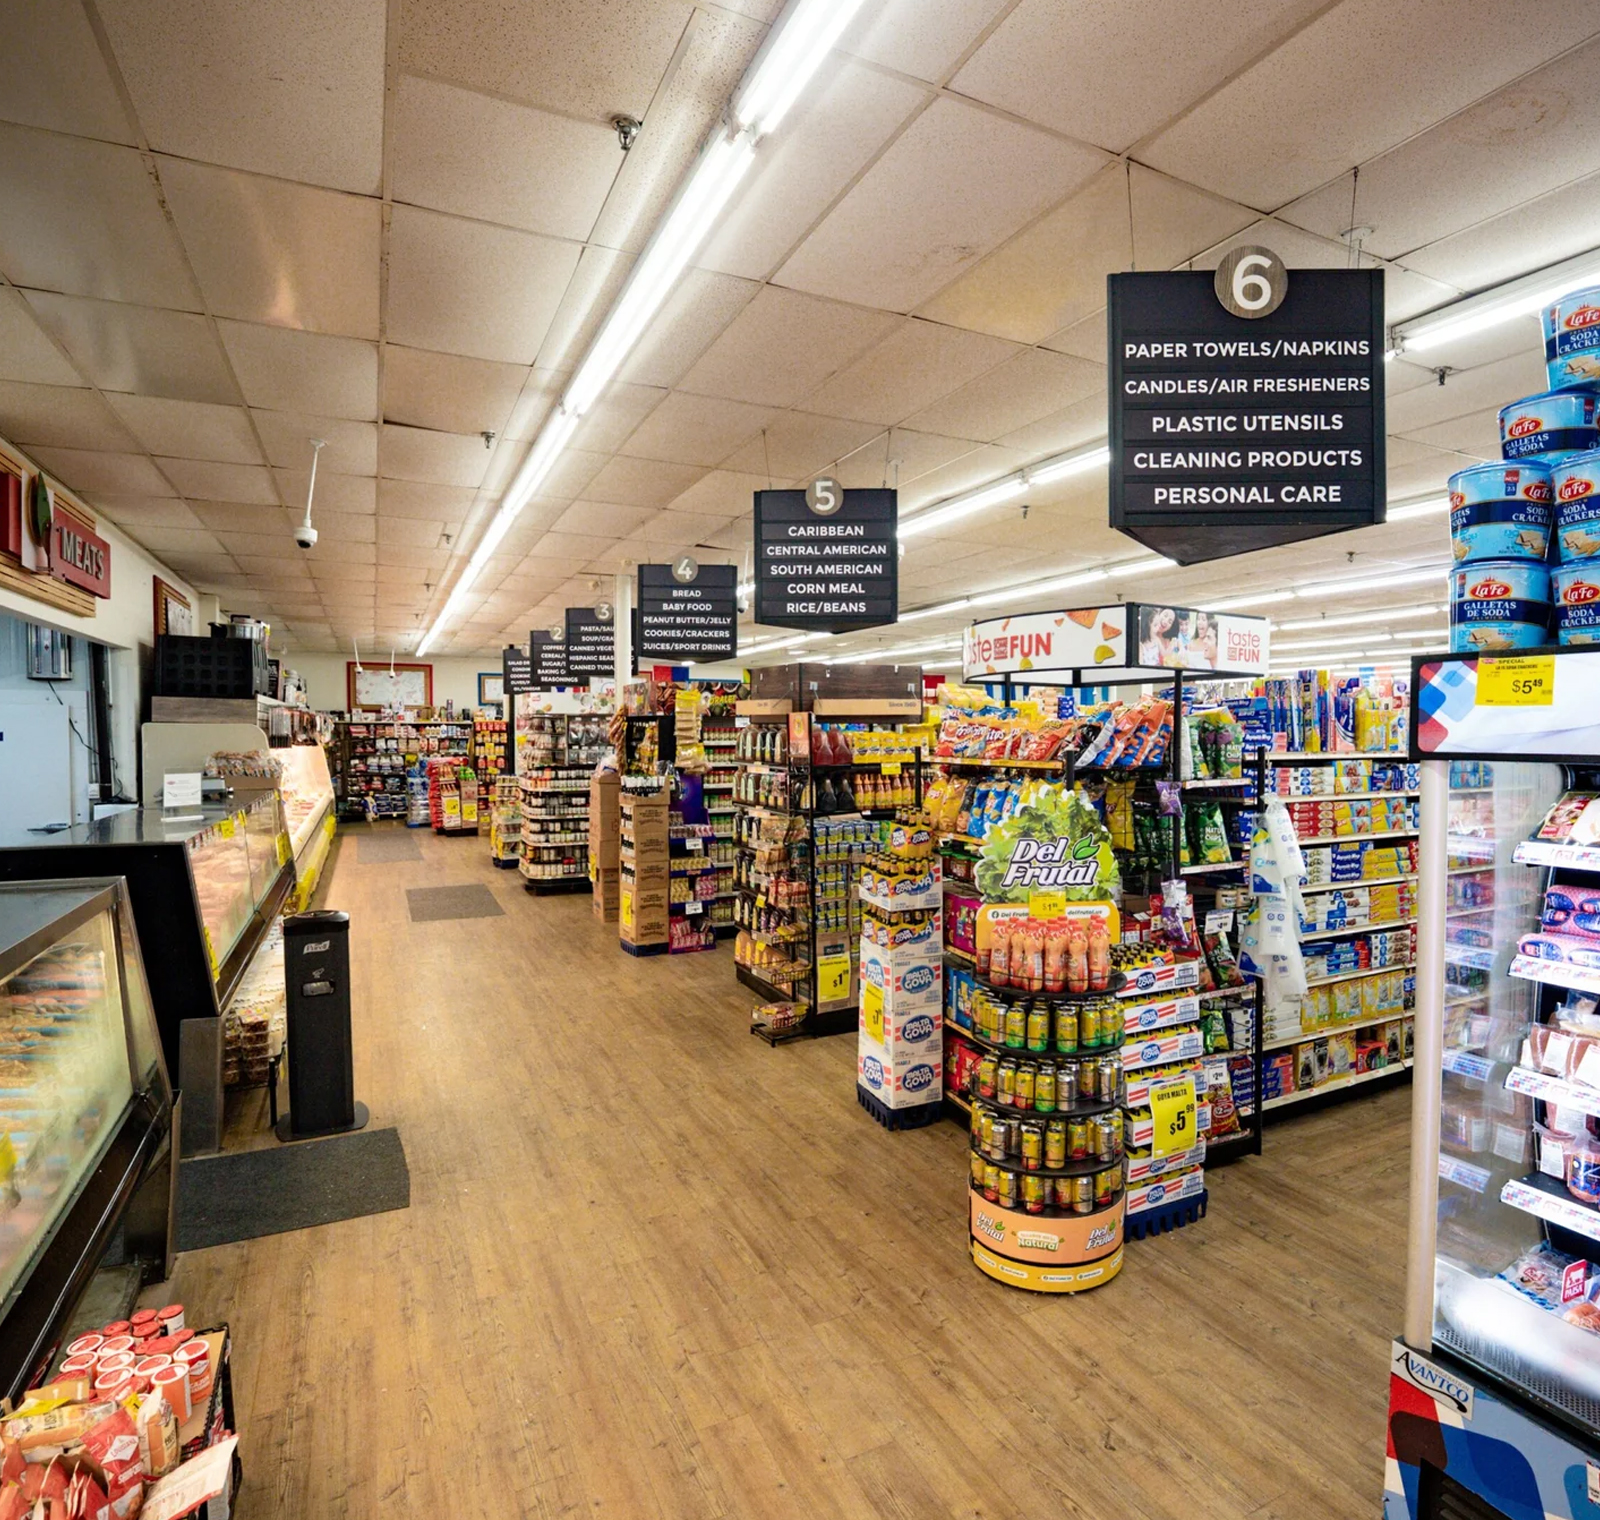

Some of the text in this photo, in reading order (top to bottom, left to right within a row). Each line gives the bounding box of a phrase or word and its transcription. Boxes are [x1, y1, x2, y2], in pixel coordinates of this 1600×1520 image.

[1232, 254, 1272, 311] 6
[1569, 330, 1599, 343] SODA
[1125, 340, 1370, 358] PAPER TOWELS/NAPKINS
[1558, 337, 1600, 354] CRACKE
[1124, 377, 1370, 395] CANDLES/AIR FRESHENERS
[1152, 414, 1343, 433] PLASTIC UTENSILS
[1505, 433, 1549, 451] GALLETAS
[1508, 442, 1544, 457] DE SODA
[1134, 450, 1362, 469] CLEANING PRODUCTS
[814, 480, 836, 511] 5
[1154, 485, 1342, 504] PERSONAL CARE
[1562, 504, 1587, 516] SODA
[788, 525, 864, 537] CARIBBEAN
[61, 528, 104, 581] MEATS
[766, 545, 887, 556] CENTRAL AMERICAN
[677, 559, 692, 579] 4
[770, 564, 882, 575] SOUTH AMERICAN
[787, 583, 865, 594] CORN MEAL
[599, 604, 610, 620] 3
[662, 603, 685, 611] BABY
[786, 602, 867, 614] RICE/BEANS
[1463, 601, 1517, 610] GALLETAS
[643, 616, 732, 625] PEANUT BUTTER/JELLY
[1467, 609, 1511, 618] DE SODA
[1568, 608, 1595, 619] SODA
[555, 627, 562, 640] 2
[644, 629, 730, 638] COOKIES/CRACKERS
[1227, 627, 1261, 648] taste
[642, 643, 700, 651] JUICES/SPORT
[1010, 632, 1052, 659] FUN
[1239, 648, 1260, 663] FUN
[1012, 837, 1069, 863] Del
[1001, 860, 1099, 888] Frutal
[904, 974, 934, 989] GOYA
[906, 968, 930, 980] MALTA
[906, 1017, 930, 1029] MALTA
[904, 1024, 934, 1038] GOYA
[904, 1073, 934, 1087] GOYA
[906, 1067, 930, 1079] MALTA
[1157, 1088, 1188, 1101] GOYA MALTA
[978, 1212, 994, 1227] Del
[976, 1219, 1005, 1243] Frutal
[1091, 1225, 1109, 1238] Del
[1017, 1237, 1060, 1253] Natural
[1085, 1230, 1117, 1251] Frutal
[1395, 1351, 1469, 1405] AVANTCO
